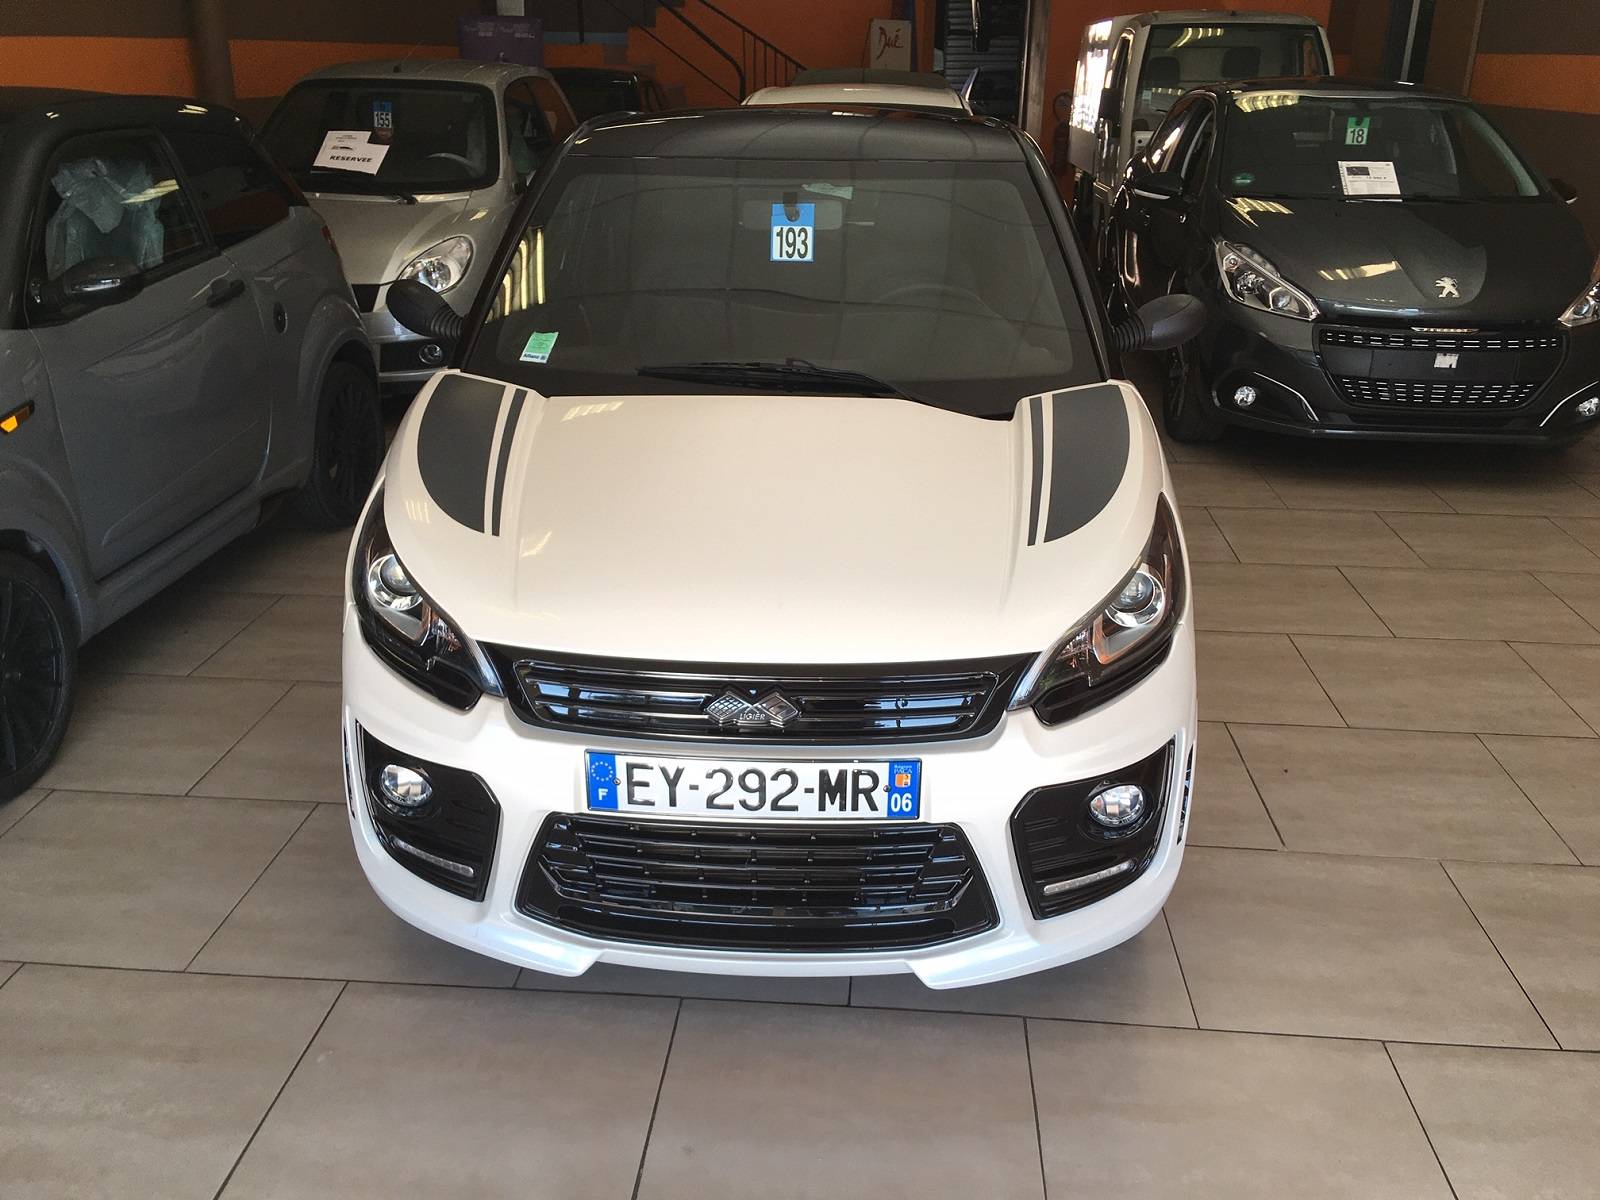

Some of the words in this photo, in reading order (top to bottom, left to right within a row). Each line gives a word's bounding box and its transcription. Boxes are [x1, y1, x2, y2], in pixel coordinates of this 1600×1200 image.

[375, 112, 390, 127] 155
[1350, 128, 1365, 143] 18
[776, 227, 808, 259] 193
[598, 788, 608, 801] F
[626, 762, 880, 813] EY-292-MR
[890, 792, 913, 813] 06
